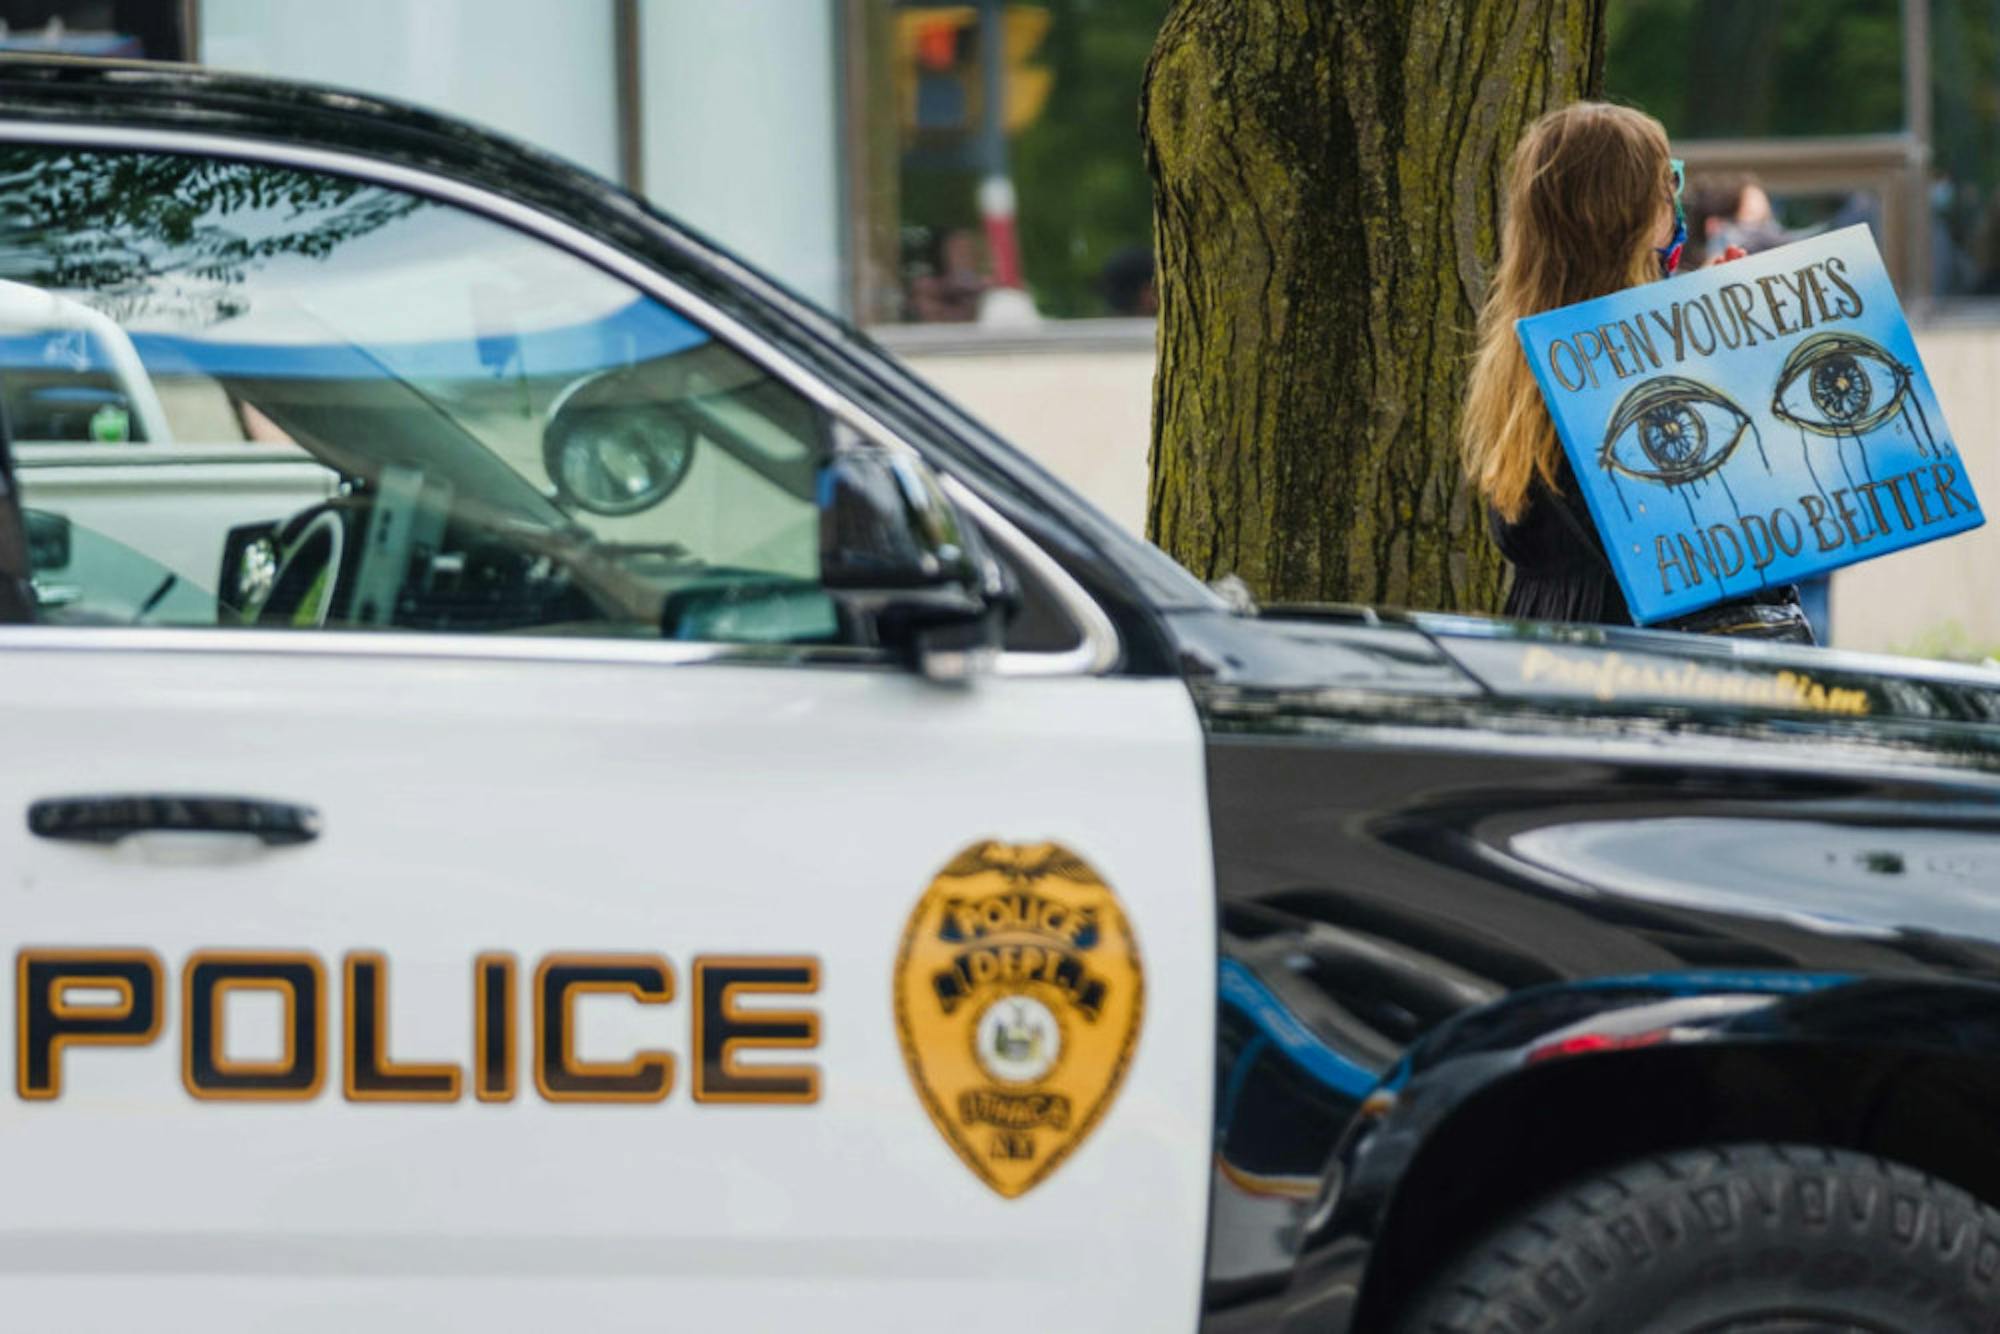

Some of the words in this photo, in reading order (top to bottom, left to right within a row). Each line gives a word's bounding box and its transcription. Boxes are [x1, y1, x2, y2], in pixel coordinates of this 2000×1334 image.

[1548, 311, 1661, 392] OPEN
[1650, 282, 1770, 361] YOUR
[1758, 257, 1863, 336] EYES
[1655, 523, 1744, 595] AND
[1739, 507, 1802, 570] DO
[1799, 463, 1976, 553] BETTER
[956, 894, 1090, 942] POLICE
[15, 947, 822, 1104] POLICE
